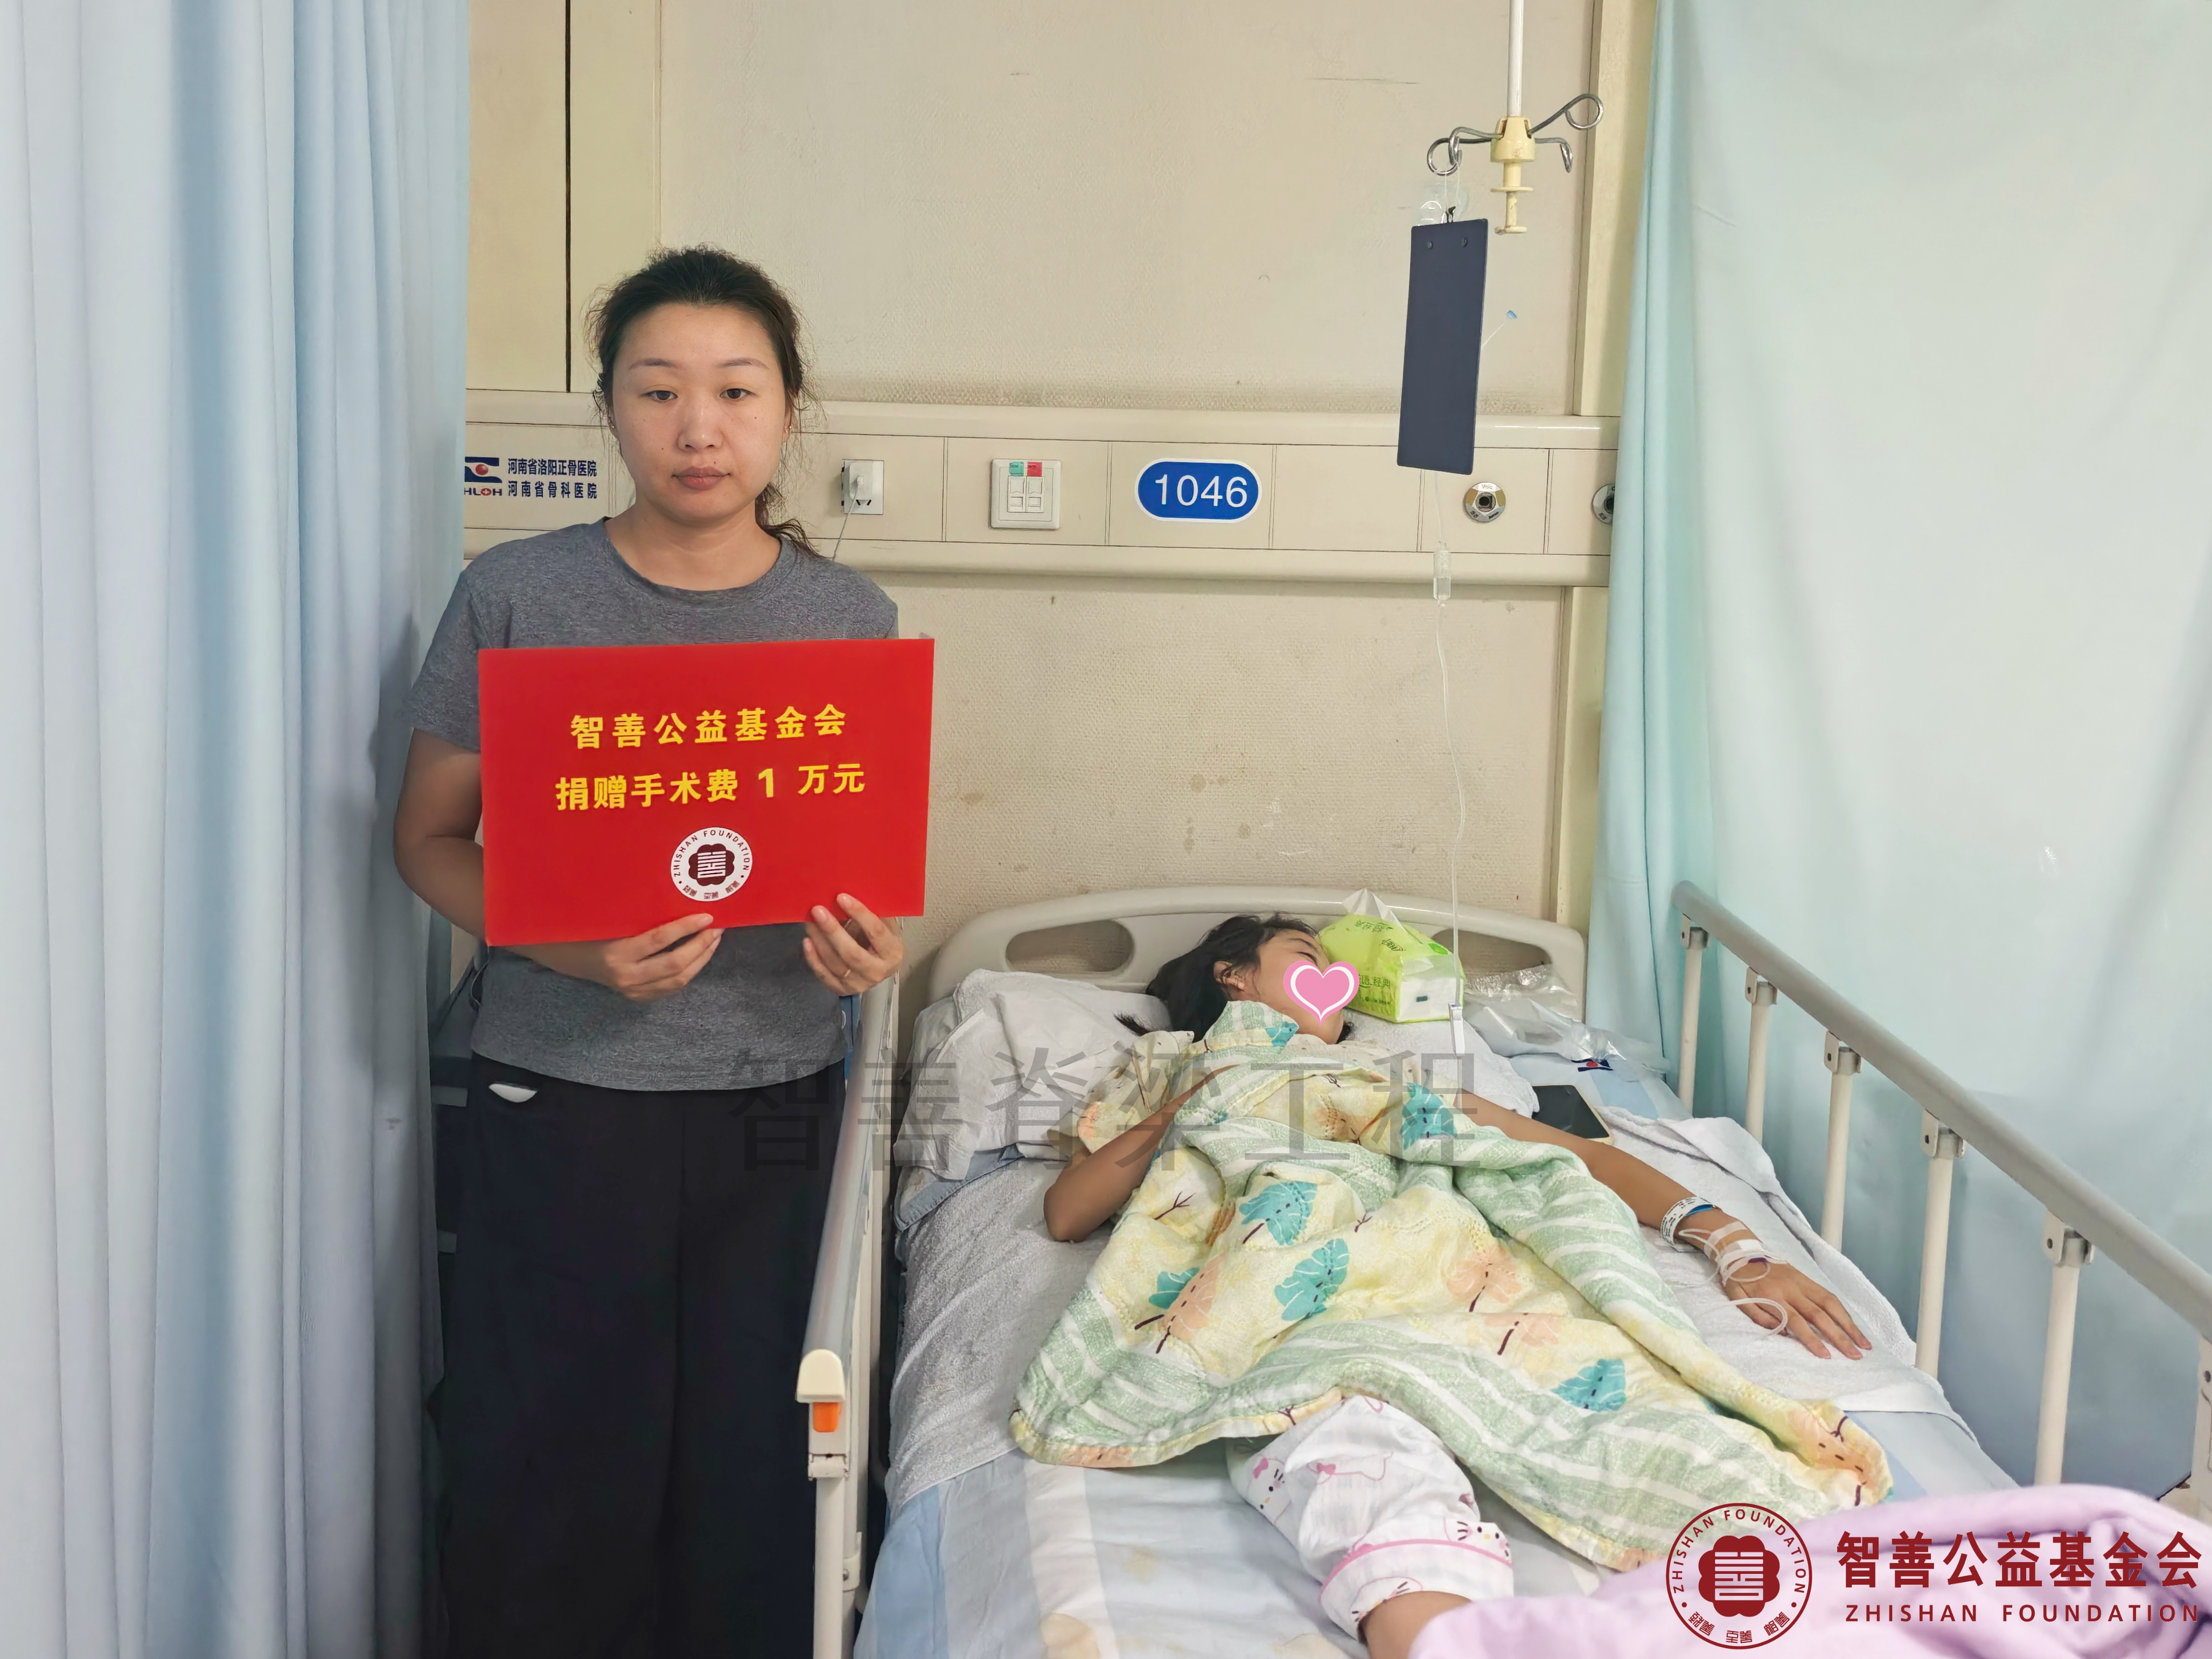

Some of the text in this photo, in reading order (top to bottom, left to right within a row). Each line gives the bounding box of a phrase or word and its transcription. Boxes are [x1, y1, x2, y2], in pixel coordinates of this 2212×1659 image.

[508, 458, 597, 477] 河南省洛阳正骨医院
[508, 480, 597, 499] 河南省骨科医院
[1155, 475, 1247, 507] 1046
[570, 704, 846, 749] 智善公益基金会
[555, 763, 866, 811] 捐赠手术费 1 万元
[673, 830, 750, 877] ZHISHAN FOUNDATION
